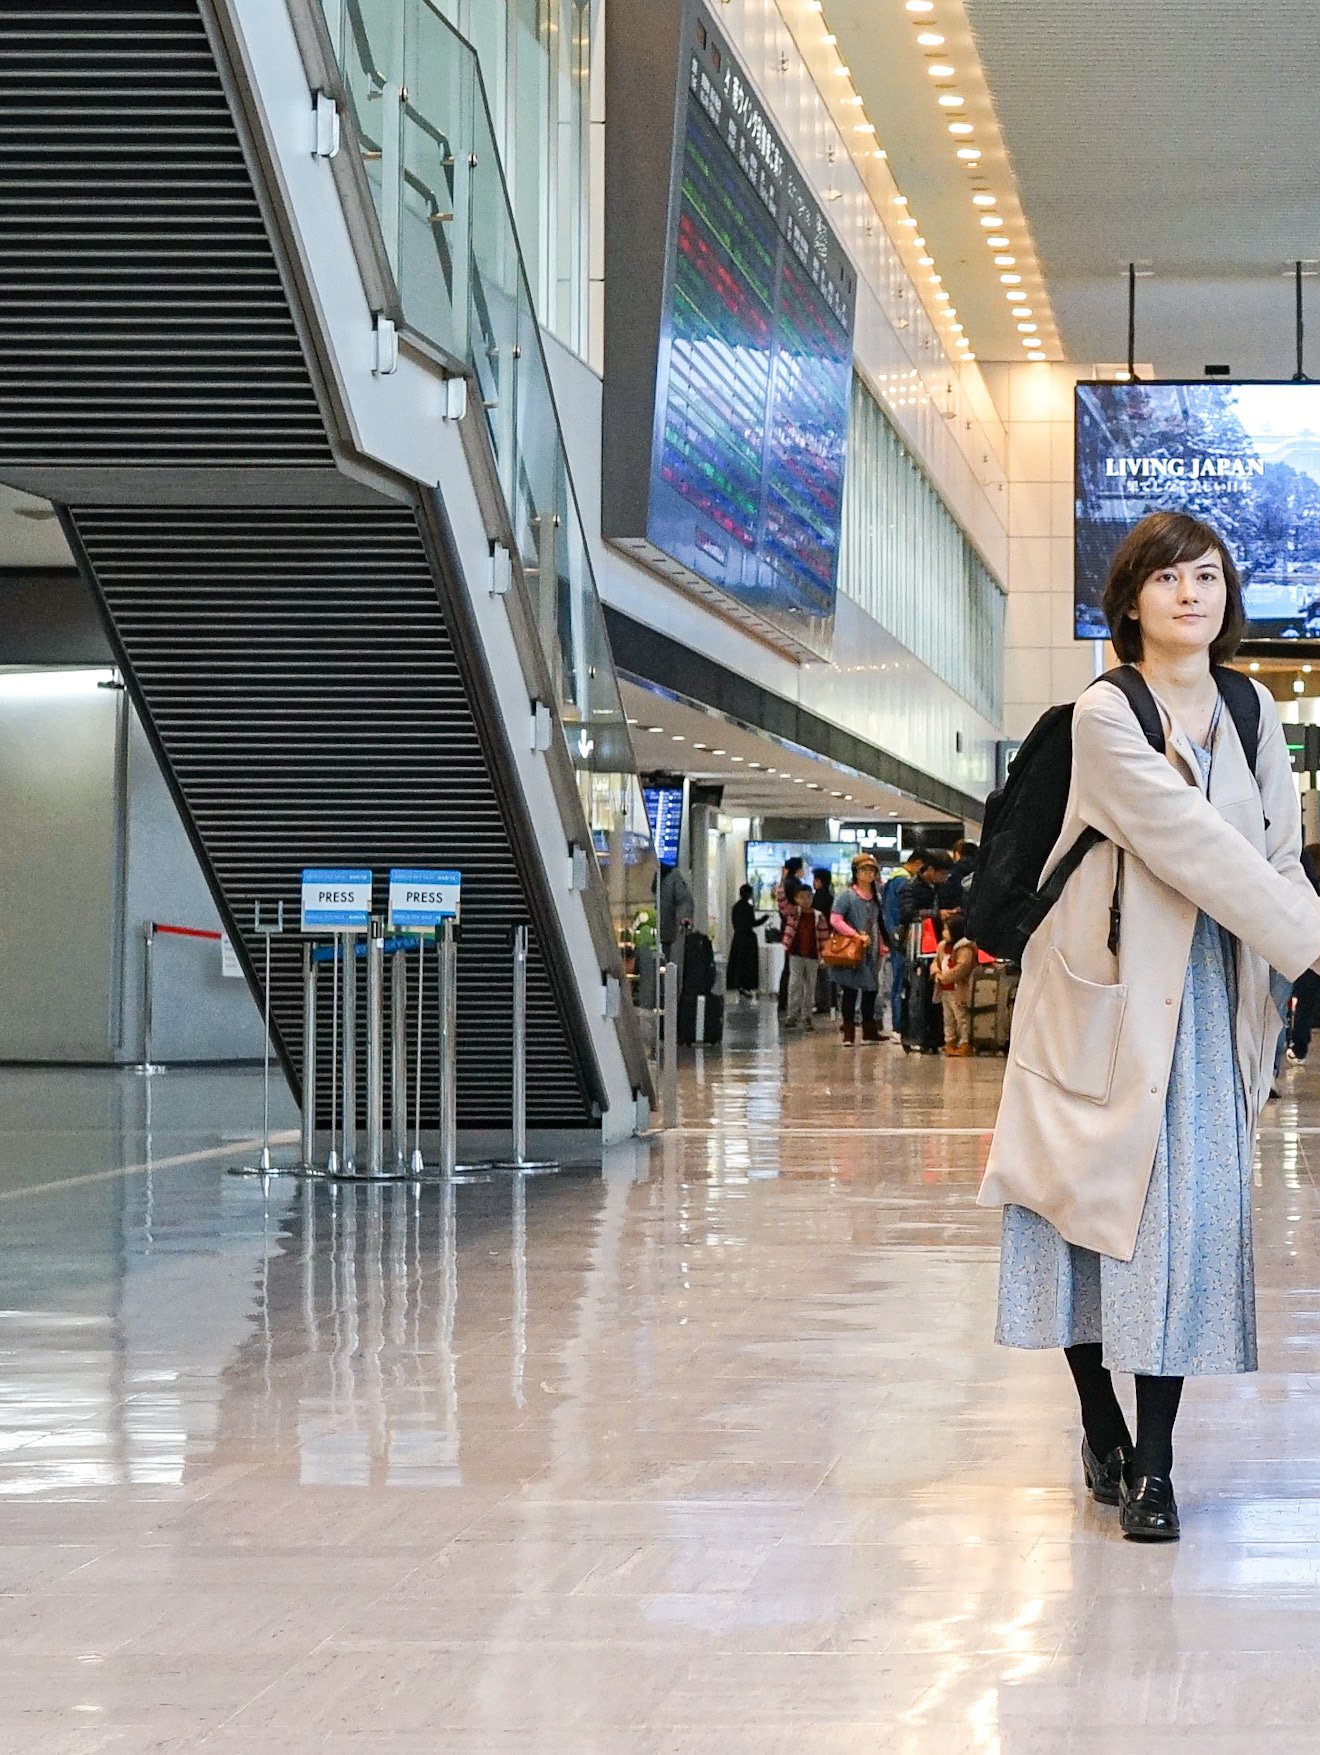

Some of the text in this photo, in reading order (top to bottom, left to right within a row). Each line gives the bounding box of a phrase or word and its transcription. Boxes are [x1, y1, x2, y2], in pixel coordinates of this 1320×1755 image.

[1105, 457, 1265, 480] LIVING JAPAN
[318, 891, 355, 903] PRESS
[406, 891, 443, 904] PRESS
